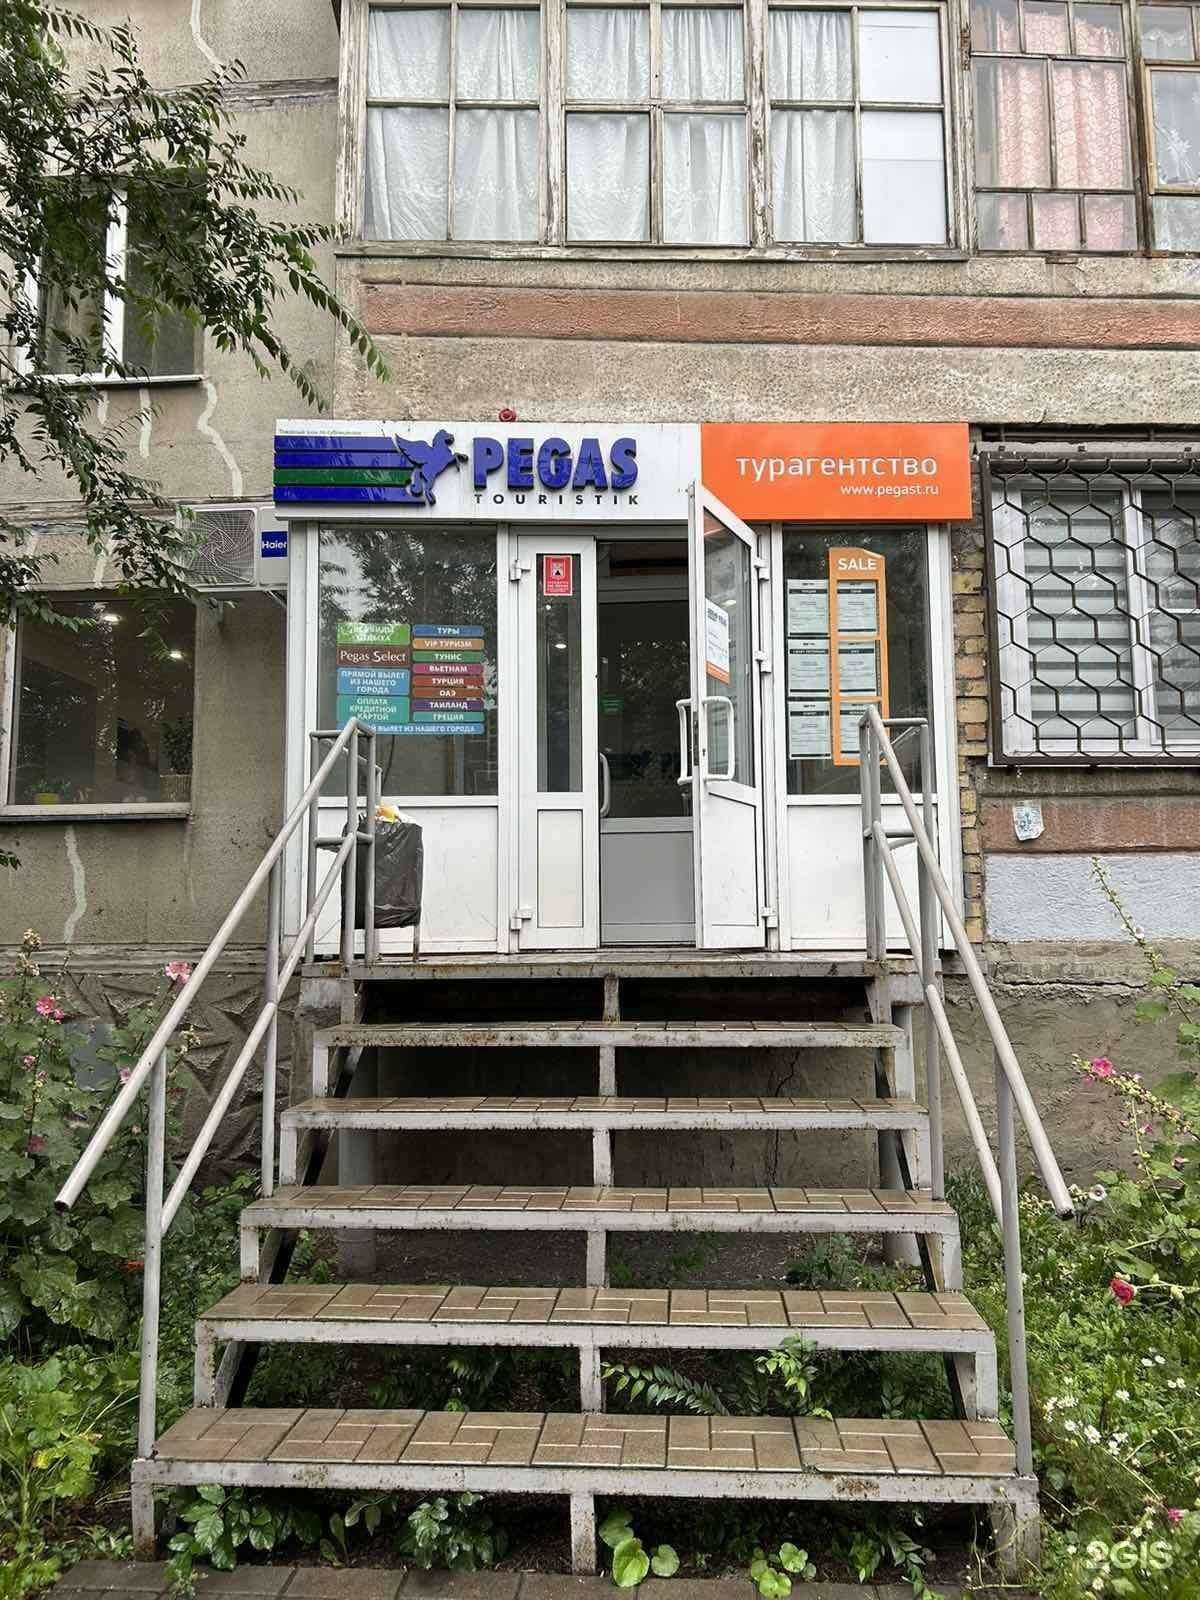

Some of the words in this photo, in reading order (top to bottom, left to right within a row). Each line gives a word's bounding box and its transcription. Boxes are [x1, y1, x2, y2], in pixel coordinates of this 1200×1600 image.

[472, 437, 639, 492] PEGAS
[736, 456, 938, 482] турагентство
[840, 484, 939, 497] www.pegast.ru
[475, 494, 639, 505] TOURISTIK
[838, 558, 878, 571] SALE
[437, 627, 460, 635] ТУРЫ
[424, 640, 438, 648] VIP
[440, 640, 473, 648] ТУРИЗМ
[340, 650, 370, 664] Pegas
[372, 650, 406, 663] Select
[434, 653, 463, 661] ТУНИС
[429, 665, 468, 673] ВЬЕТНАМ
[341, 670, 377, 678] ПРЯМОЙ
[362, 678, 397, 687] НАШЕГО
[432, 678, 465, 686] ТУРЦИЯ
[357, 686, 390, 694] ГОРОДА
[349, 705, 398, 714] КРЕДИТНОЙ
[357, 712, 390, 721] КАРТОЙ
[433, 713, 465, 721] ГРЕЦИЯ
